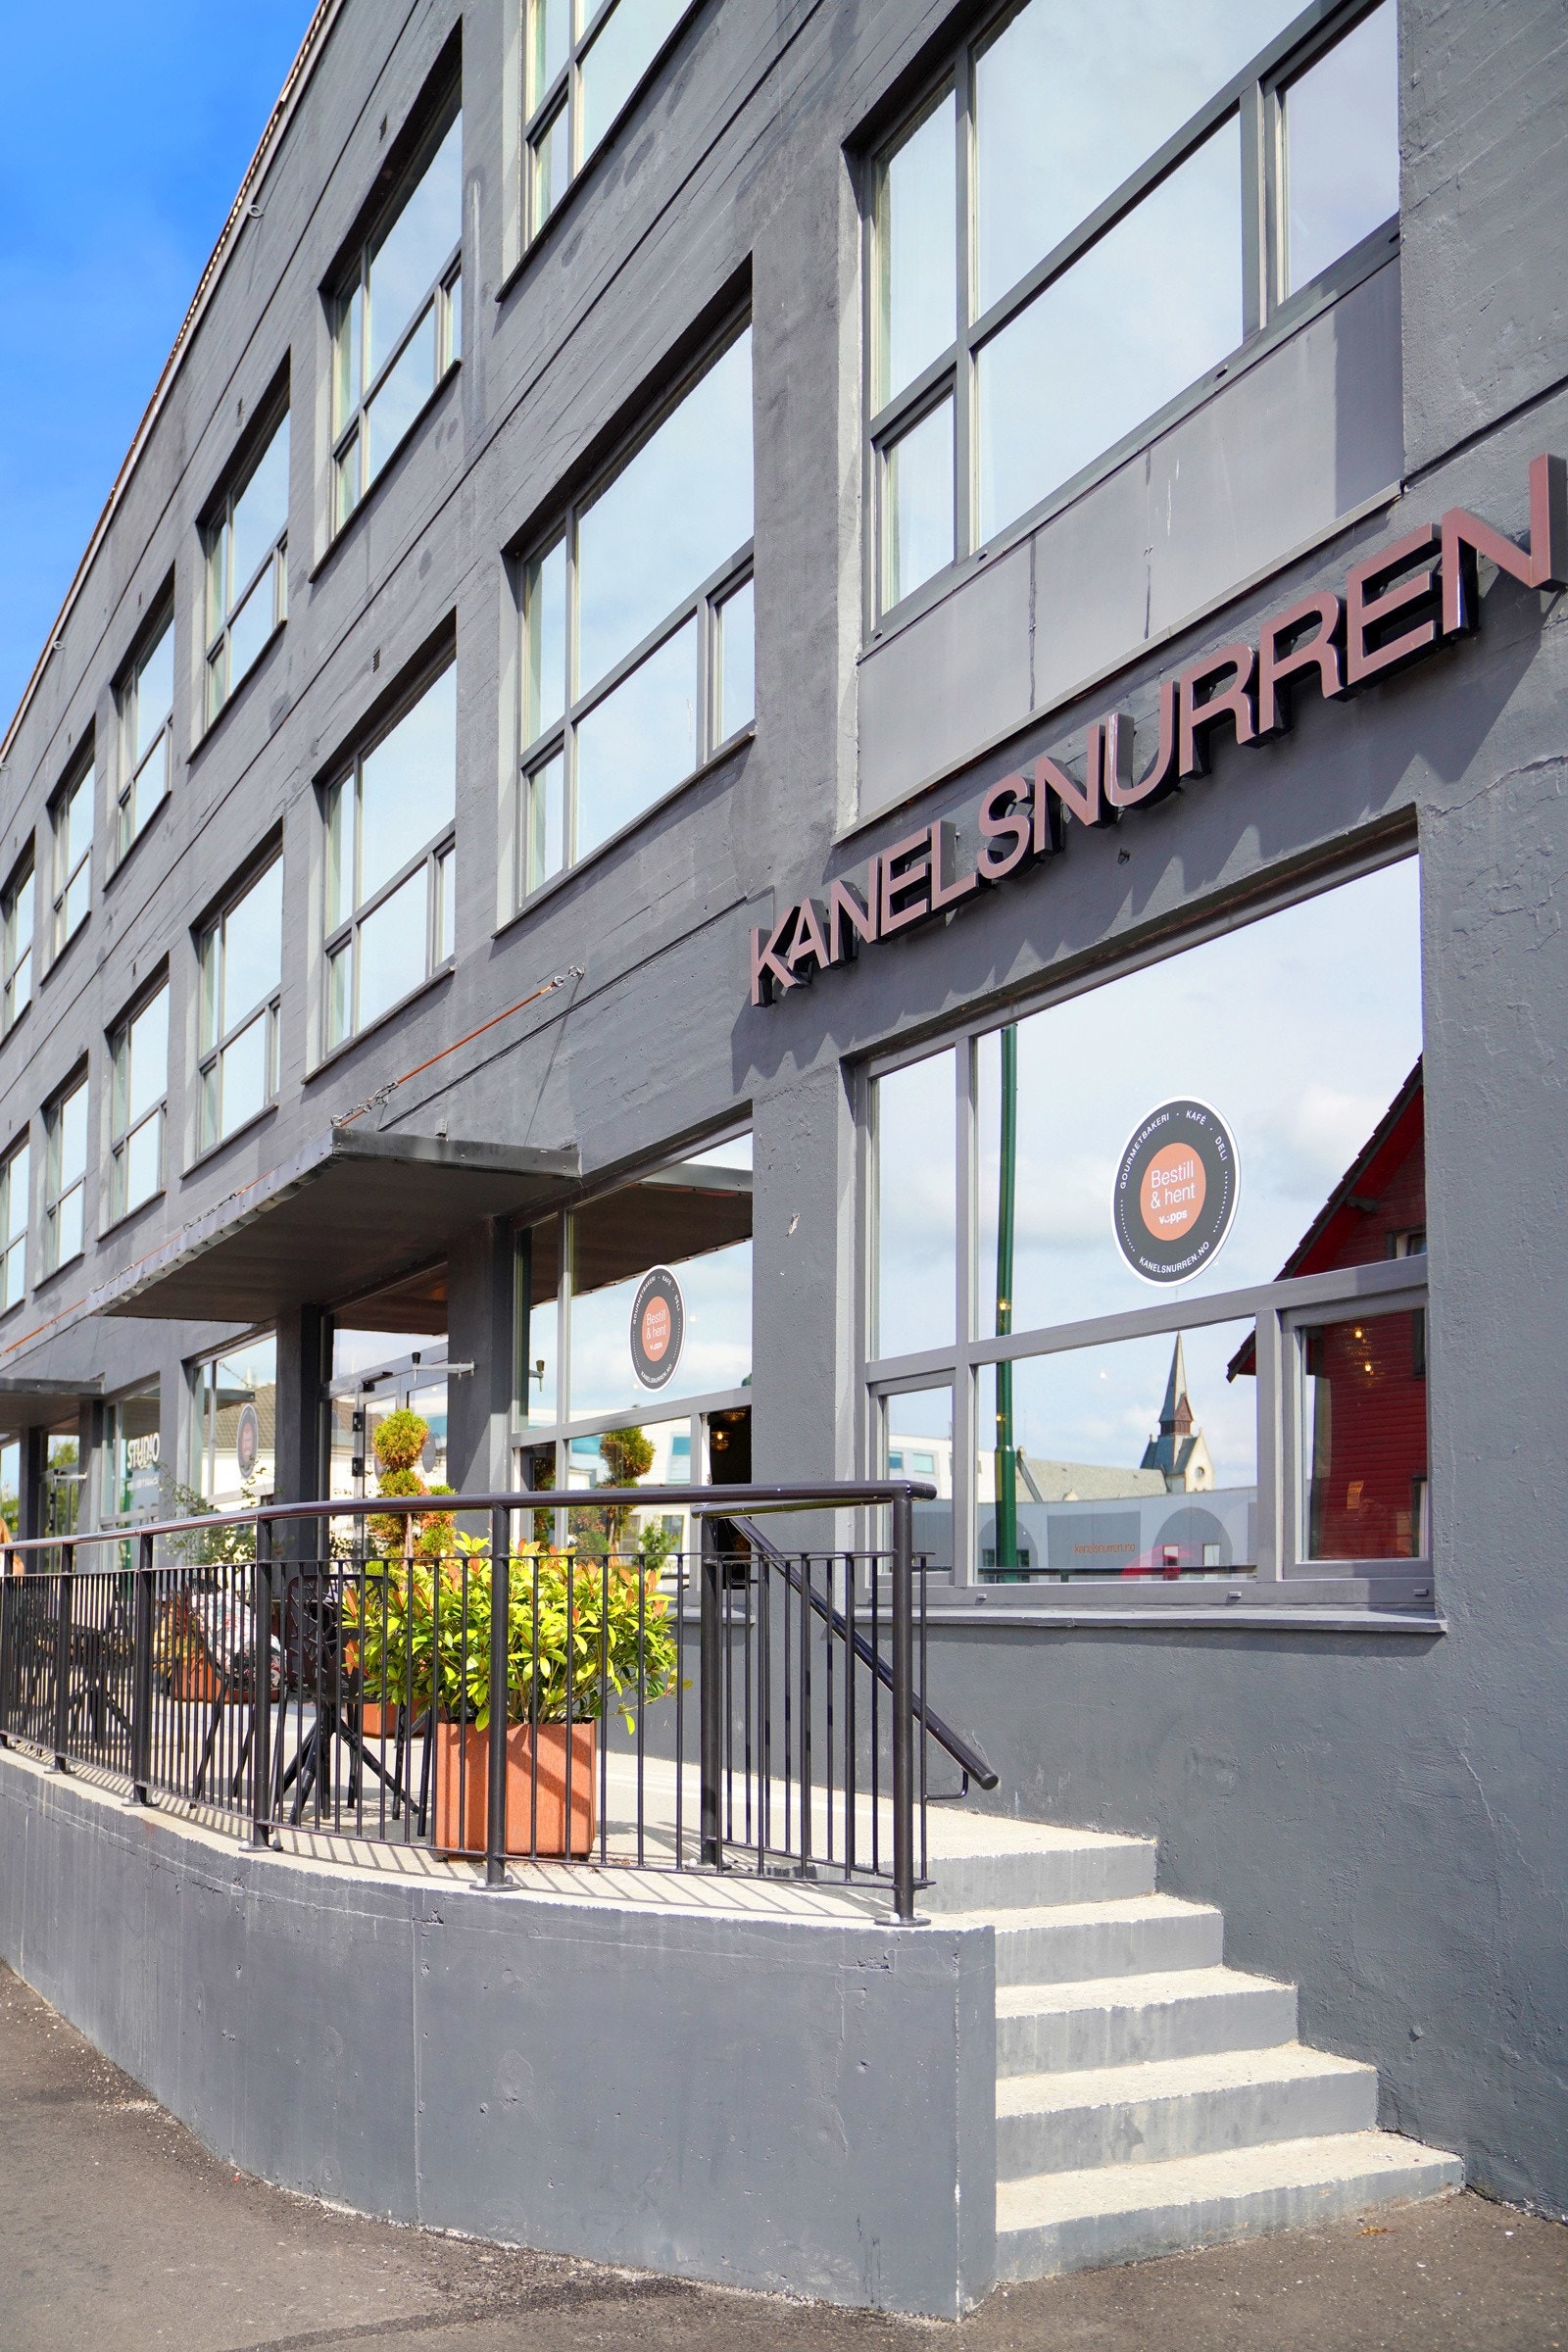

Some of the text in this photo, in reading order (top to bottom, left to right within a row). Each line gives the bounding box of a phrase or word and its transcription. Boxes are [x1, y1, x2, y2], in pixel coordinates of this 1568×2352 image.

[750, 452, 1565, 1007] KANELSNURREN
[1120, 1109, 1229, 1190] GOURMETBAKERI KAFÉ DELI
[1151, 1160, 1195, 1189] Bestill
[1151, 1182, 1196, 1209] & hent
[1139, 1241, 1210, 1274] KANELSNURREN.NO
[646, 1308, 666, 1326] Bestill
[646, 1324, 666, 1340] & hent
